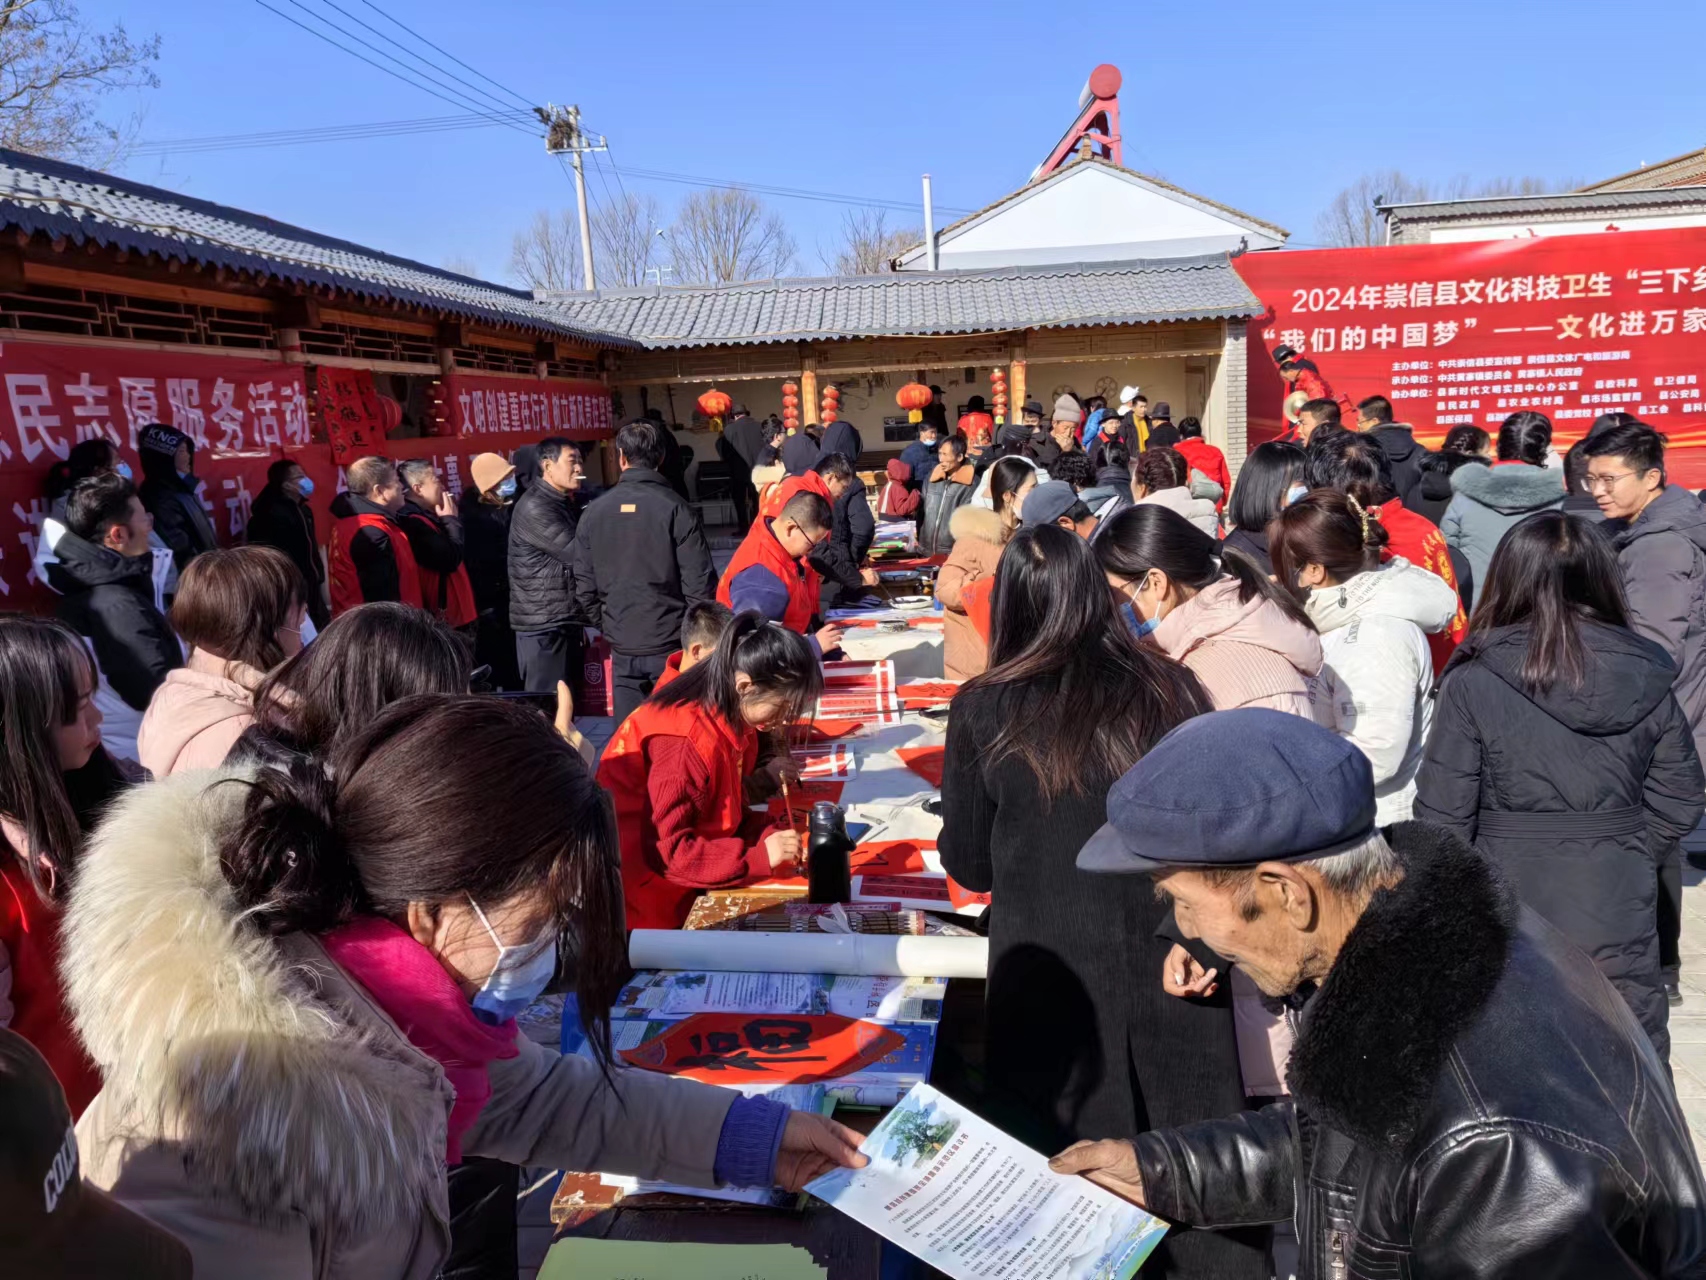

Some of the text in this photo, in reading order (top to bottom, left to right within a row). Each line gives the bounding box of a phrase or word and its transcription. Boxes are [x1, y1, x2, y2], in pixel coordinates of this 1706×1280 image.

[1653, 375, 1697, 386] 县卫健局
[1497, 395, 1564, 408] 县农业农村局
[1659, 389, 1700, 401] 县公安局
[459, 388, 550, 434] 文明创建重在行动
[1638, 405, 1669, 415] 县工会
[1682, 402, 1706, 413] 县科
[0, 373, 310, 464] 民志愿服务活动
